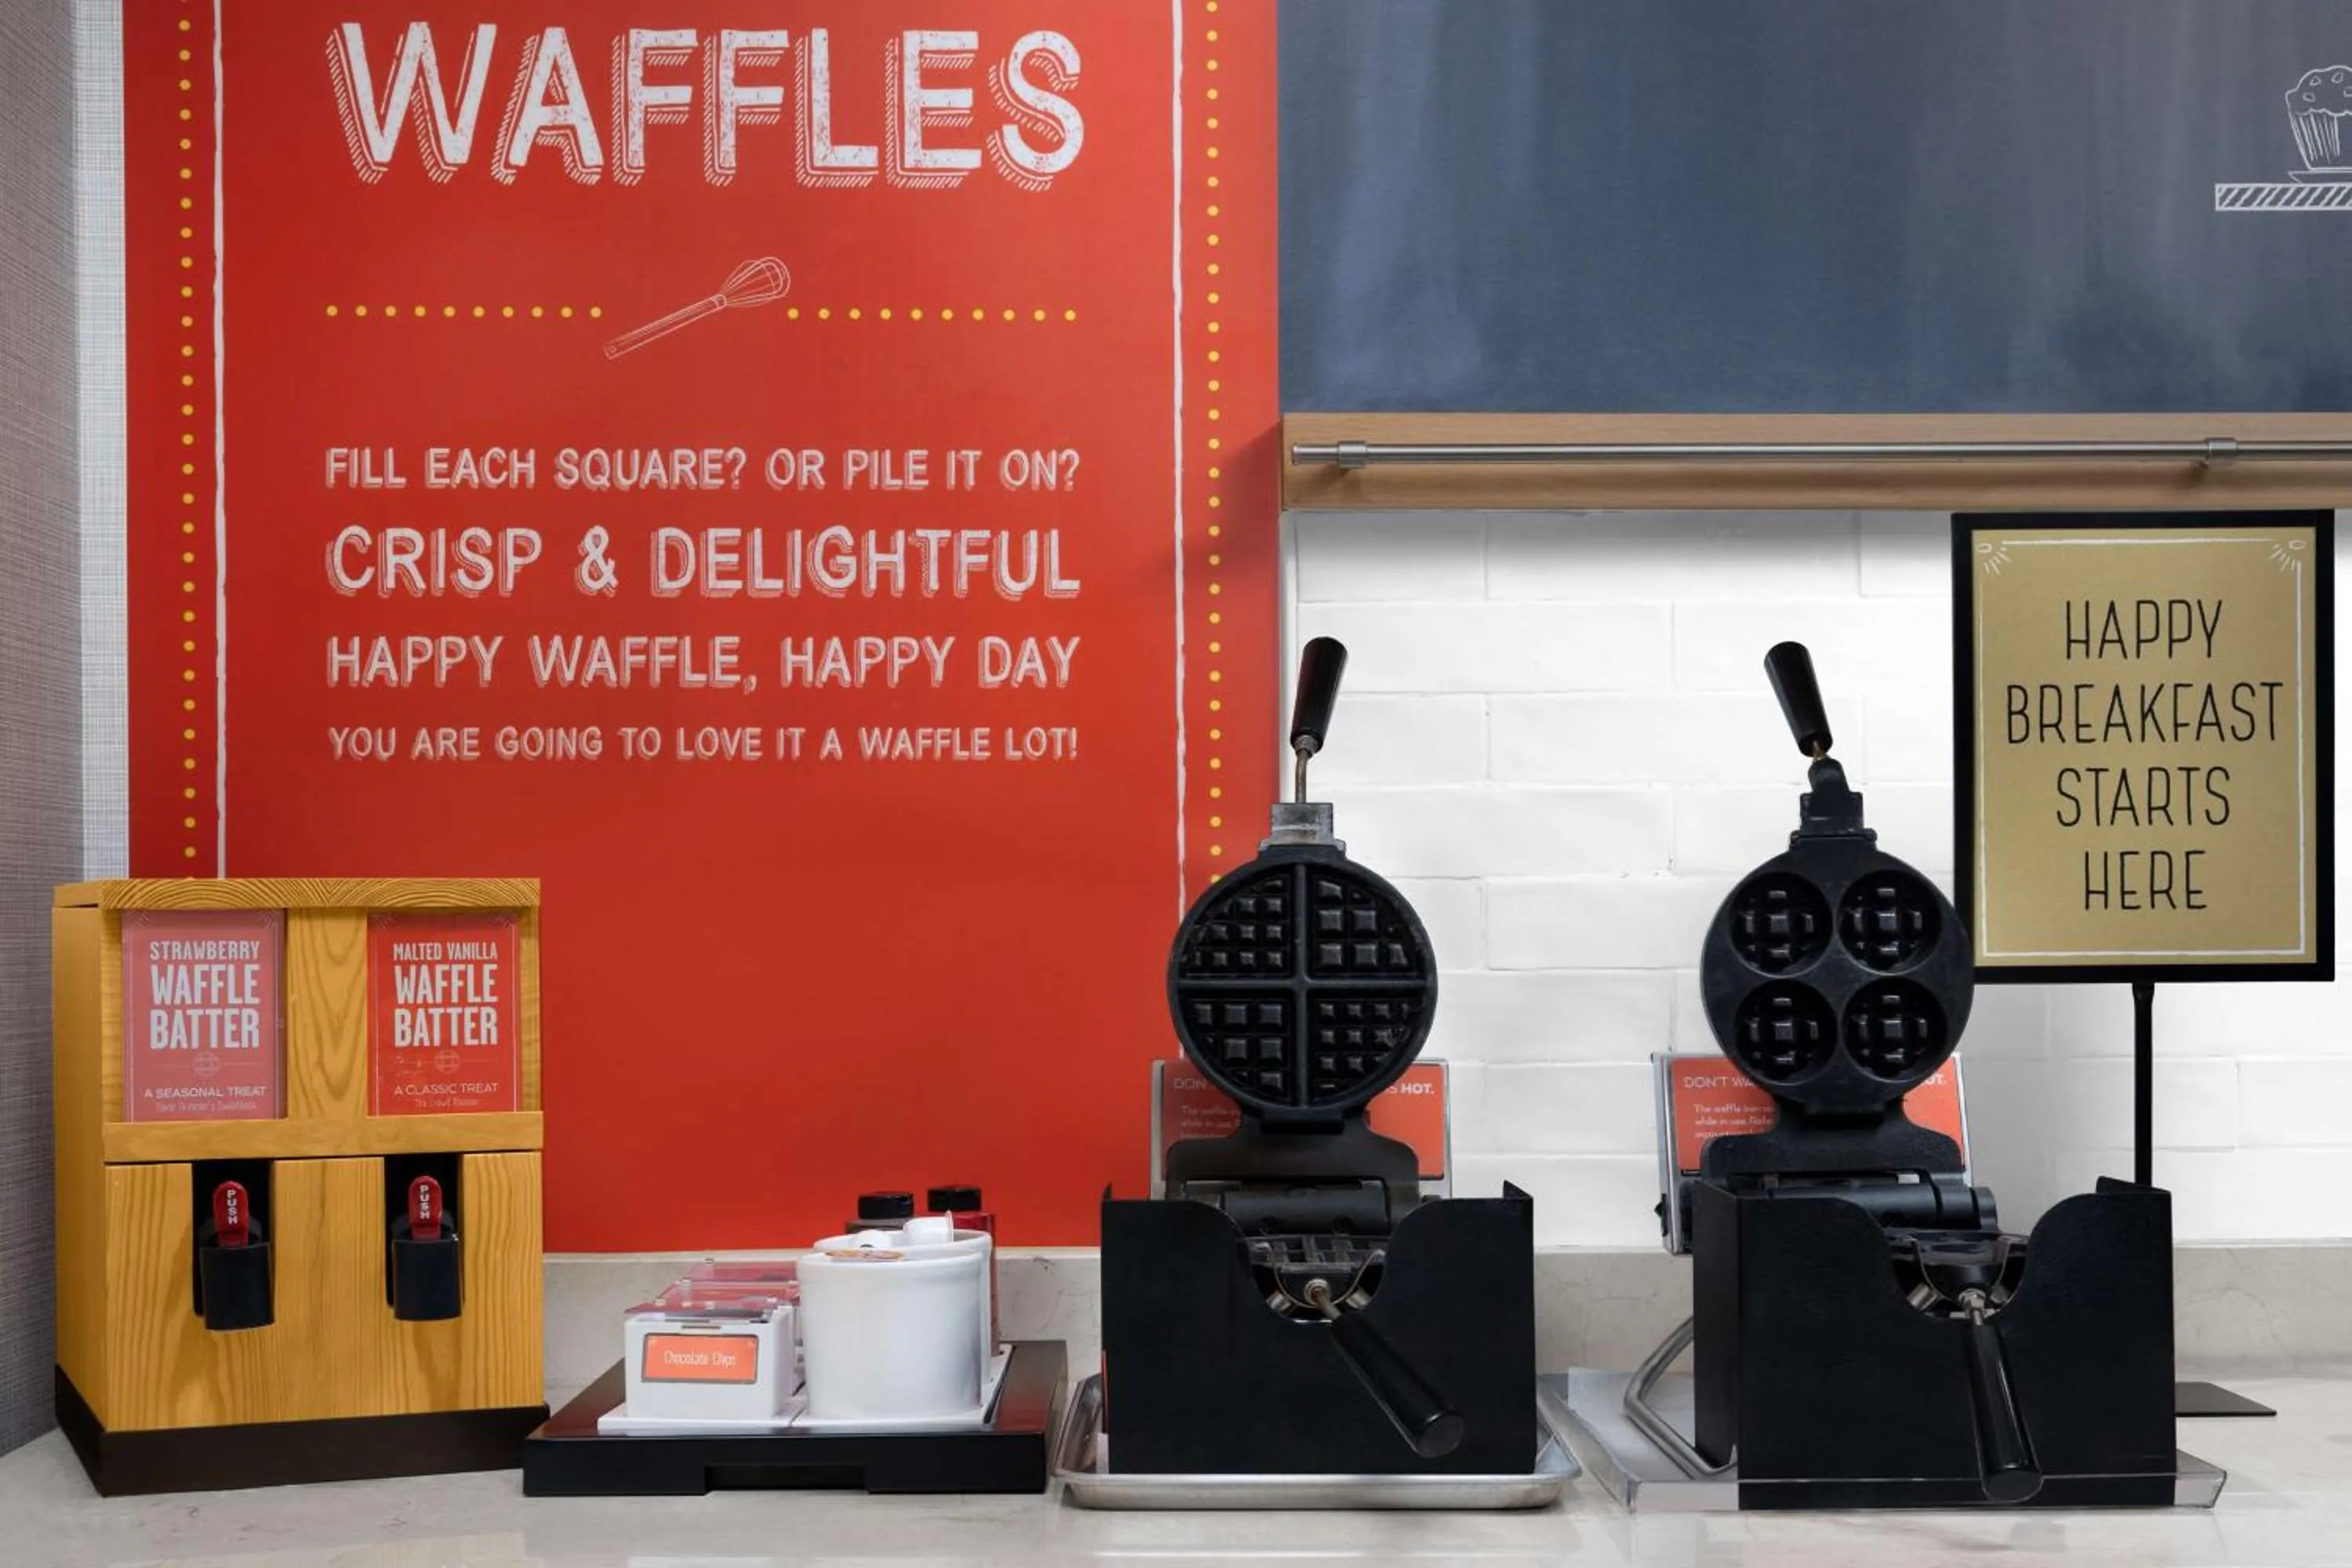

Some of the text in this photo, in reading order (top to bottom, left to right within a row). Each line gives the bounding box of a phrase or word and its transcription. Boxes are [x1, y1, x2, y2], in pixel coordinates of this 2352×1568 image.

[326, 22, 1084, 192] WAFFLES
[325, 447, 1080, 491] FILL EACH SQUARE? OR PILE IT ON?
[325, 524, 1081, 601] CRISP & DELIGHTFUL
[2065, 599, 2223, 659] HAPPY
[326, 635, 1081, 695] HAPPY WAFFLE, HAPPY DAY
[2005, 681, 2284, 744] BREAKFAST
[327, 725, 1079, 761] YOU ARE GOING TO LOVE IT A WAFFLE LOT!
[2056, 765, 2230, 827] STARTS
[2083, 850, 2208, 911] HERE
[150, 940, 260, 961] STRAWBERRY
[393, 941, 499, 961] MALTED VANILLA
[151, 964, 261, 1006] WAFFLE
[394, 964, 499, 1004] WAFFLE
[150, 1007, 260, 1051] BATTER
[394, 1007, 498, 1048] BATTER
[144, 1085, 267, 1098] A SEASONAL TREAT
[394, 1083, 499, 1096] A CLASSIC TREAT
[1400, 1083, 1435, 1095] HOT.
[1683, 1076, 1729, 1088] DON'T
[227, 1189, 238, 1225] PUSH
[419, 1185, 430, 1219] PUSH
